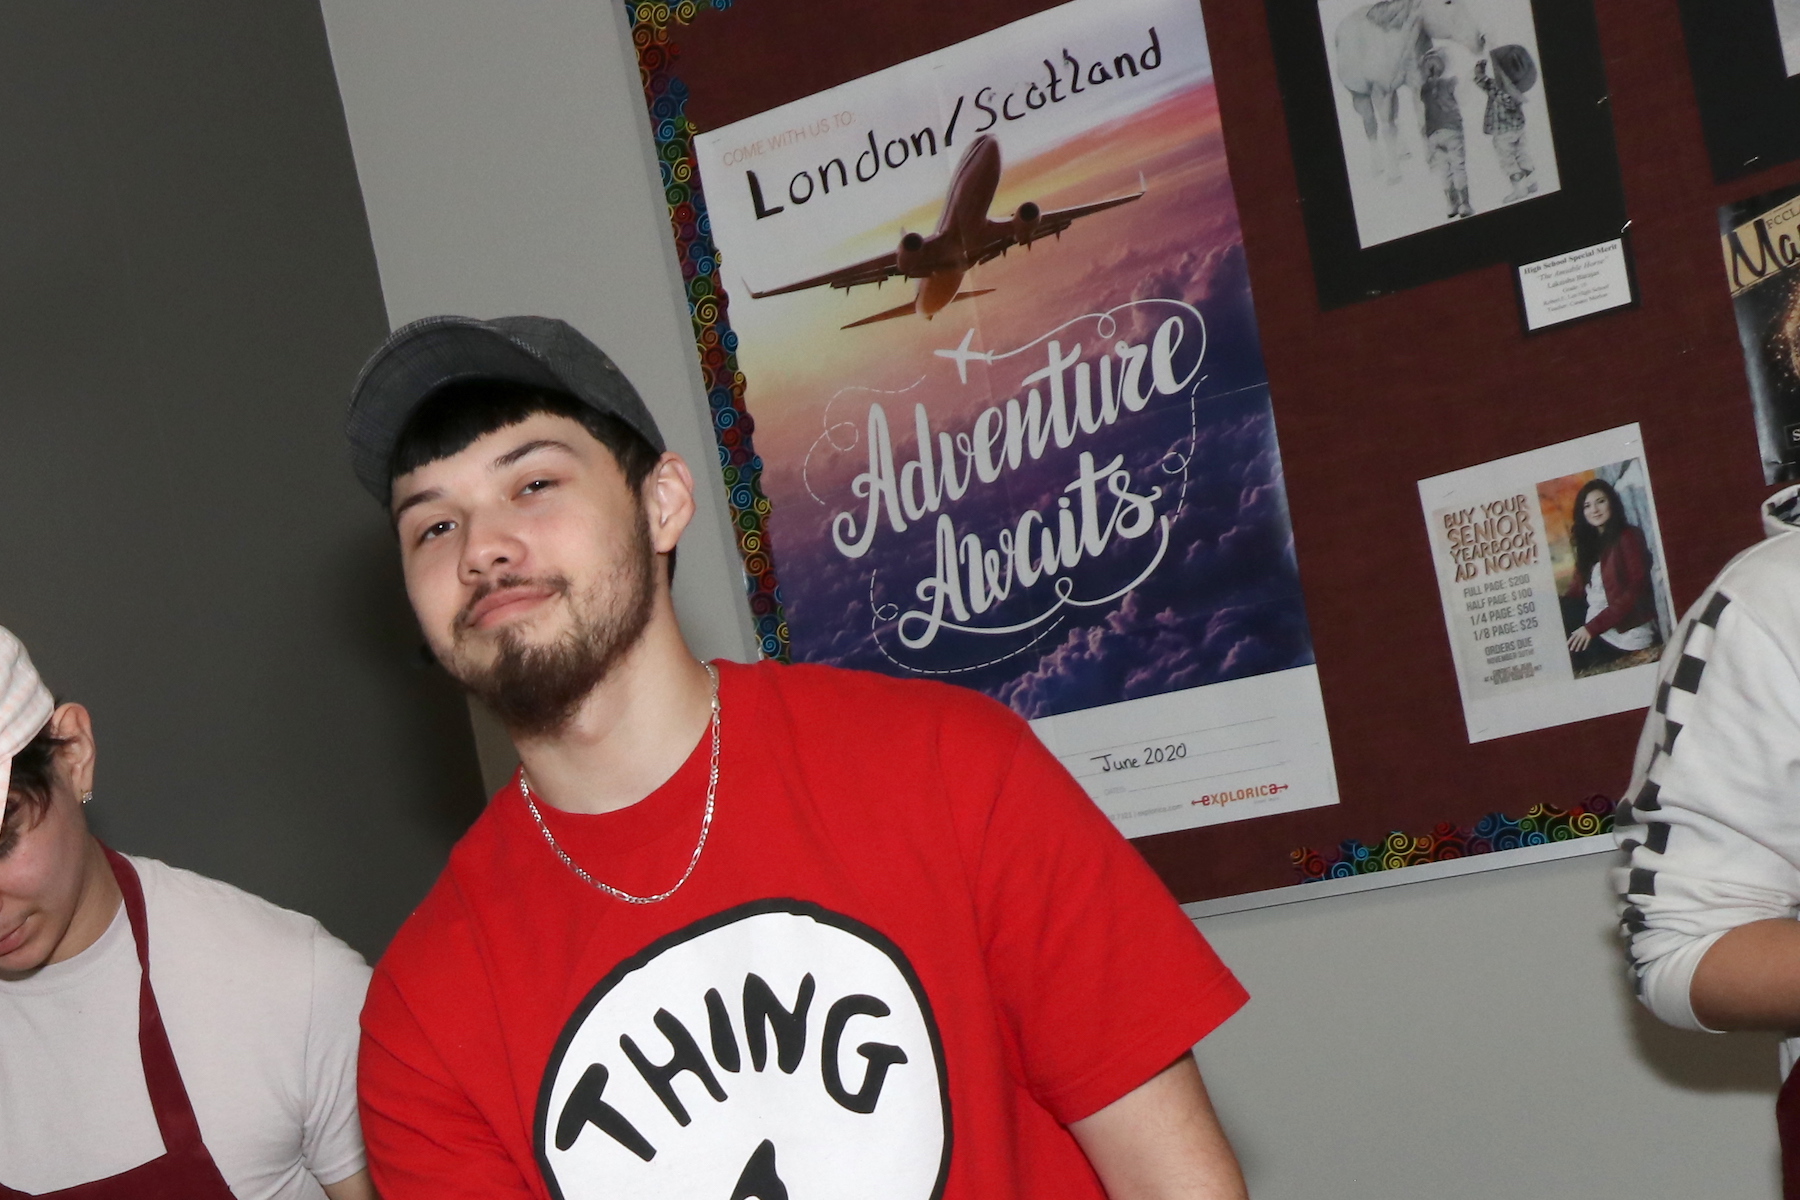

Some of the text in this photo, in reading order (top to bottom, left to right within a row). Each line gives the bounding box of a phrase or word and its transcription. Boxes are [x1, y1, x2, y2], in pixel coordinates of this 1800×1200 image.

[723, 140, 765, 167] COME
[767, 126, 806, 150] WITH
[809, 118, 830, 137] US
[1524, 243, 1618, 275] High School Special Merit
[831, 314, 1188, 560] Adventure
[1443, 494, 1530, 529] BUY YOUR
[1447, 510, 1535, 550] SENIOR
[898, 450, 1163, 650] Awaits
[1449, 531, 1537, 564] YEARBOOK
[1455, 544, 1538, 583] AD NOW!
[1463, 585, 1483, 598] FULL
[1466, 598, 1486, 611] HALF
[1511, 587, 1533, 601] $100
[1470, 612, 1488, 626] 1/4
[1517, 601, 1536, 615] $50
[1473, 616, 1539, 641] 1/8 PAGE: $25
[1484, 637, 1533, 656] ORDERS DUE
[1090, 742, 1187, 773] June 2020
[555, 972, 909, 1162] THING
